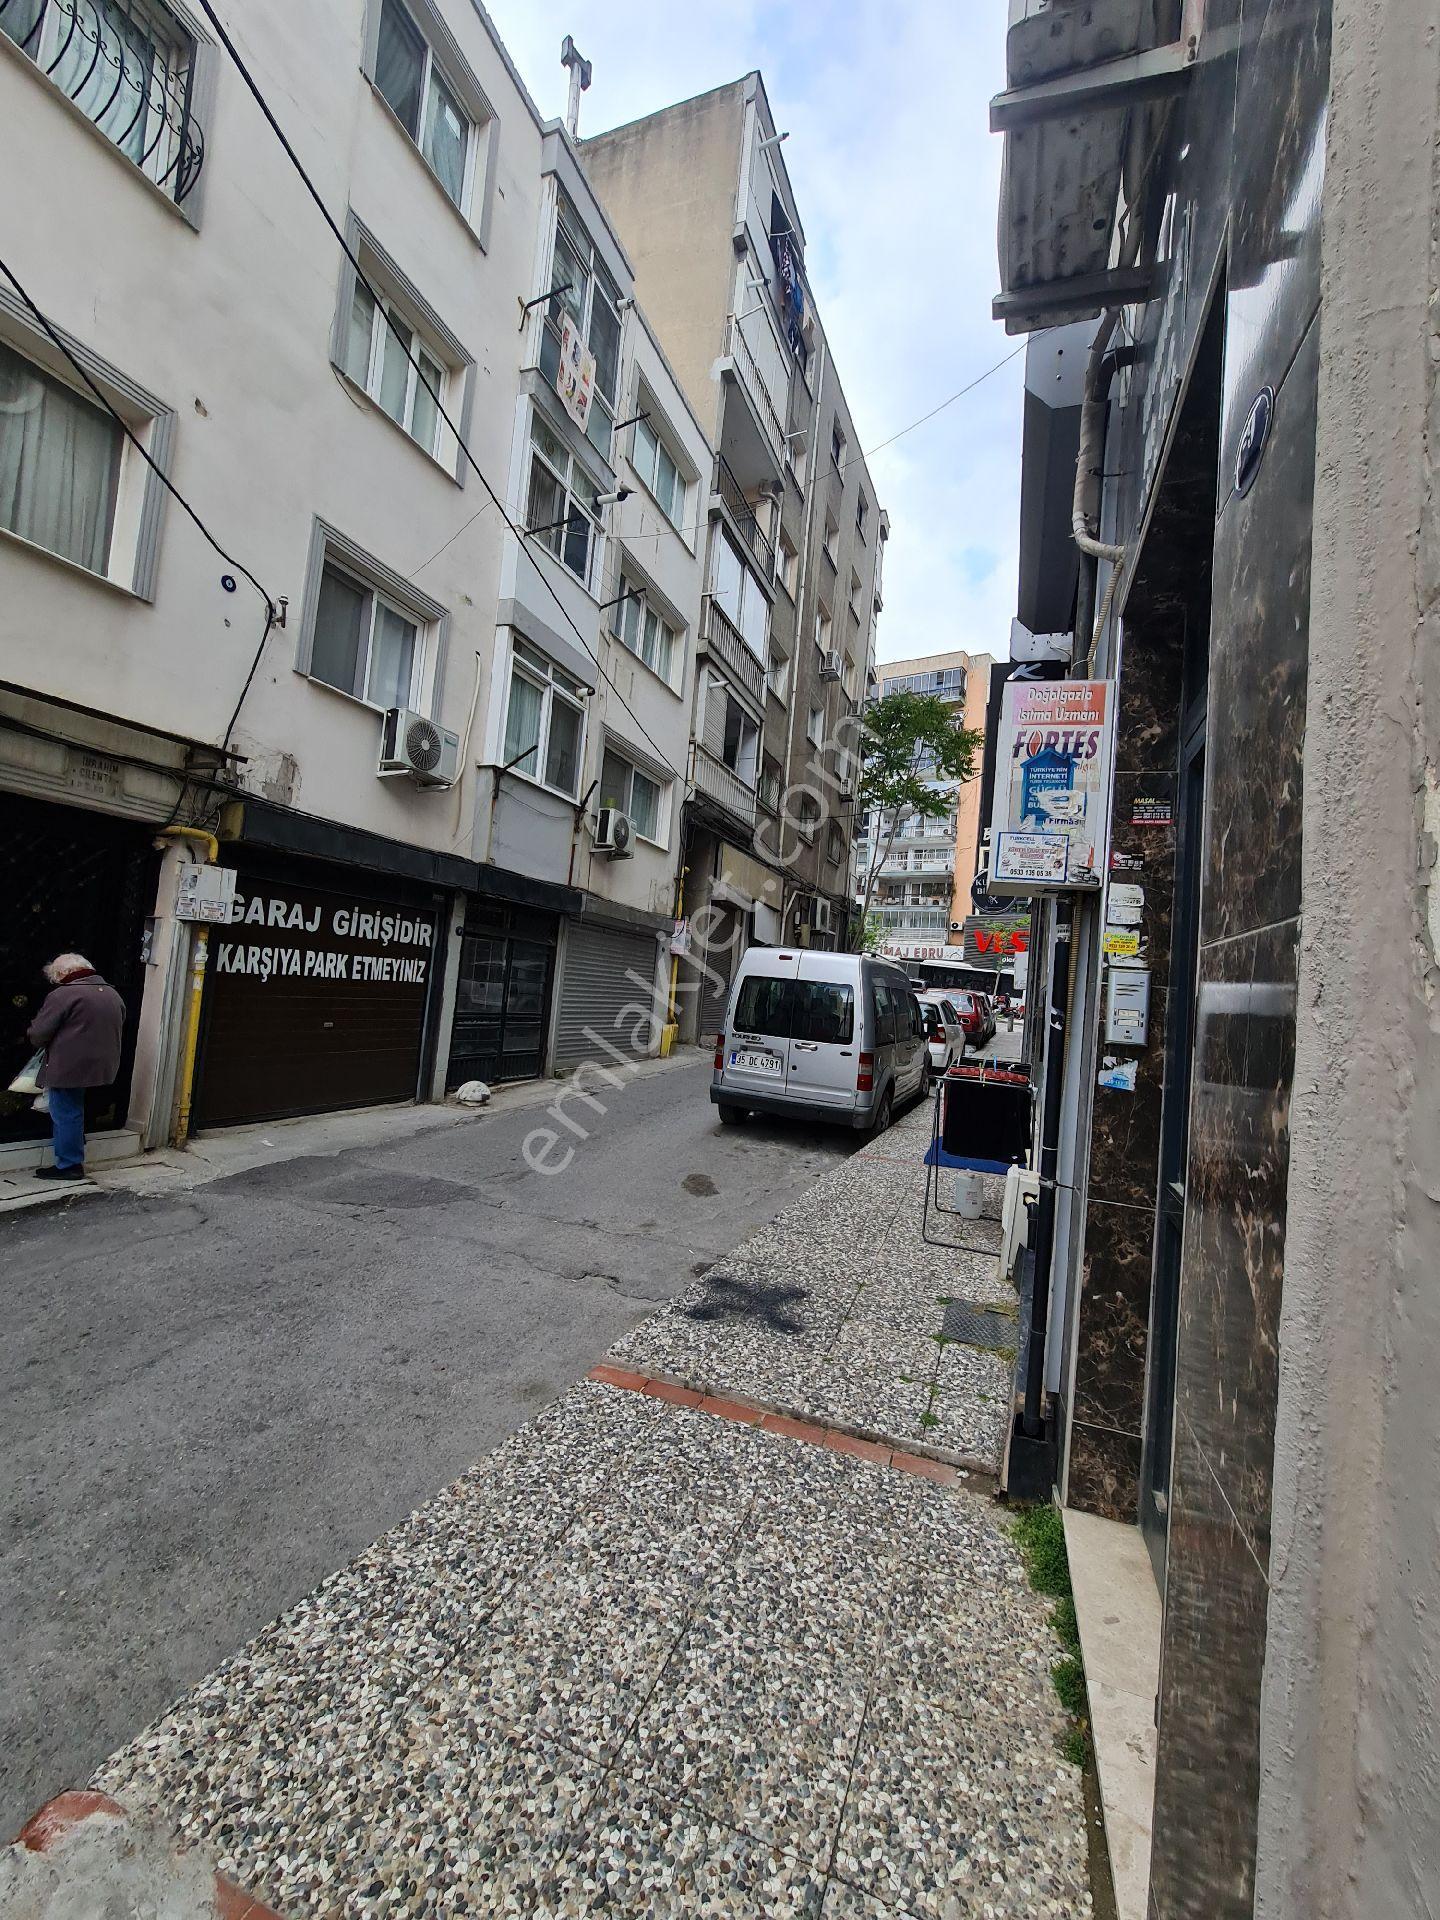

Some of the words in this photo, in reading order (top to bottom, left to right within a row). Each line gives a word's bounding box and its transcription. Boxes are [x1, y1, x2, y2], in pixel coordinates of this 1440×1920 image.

[1029, 686, 1093, 703] Doğalgazla
[1012, 730, 1100, 760] FORTES
[232, 893, 322, 932] GARAJ
[332, 906, 433, 947] GİRİŞİDİR
[216, 943, 301, 983] KARŞIYA
[303, 950, 349, 979] PARK
[351, 955, 427, 983] ETMEYİNİZ
[913, 947, 944, 959] EBRU
[736, 1055, 746, 1064] 35
[748, 1056, 758, 1066] DC
